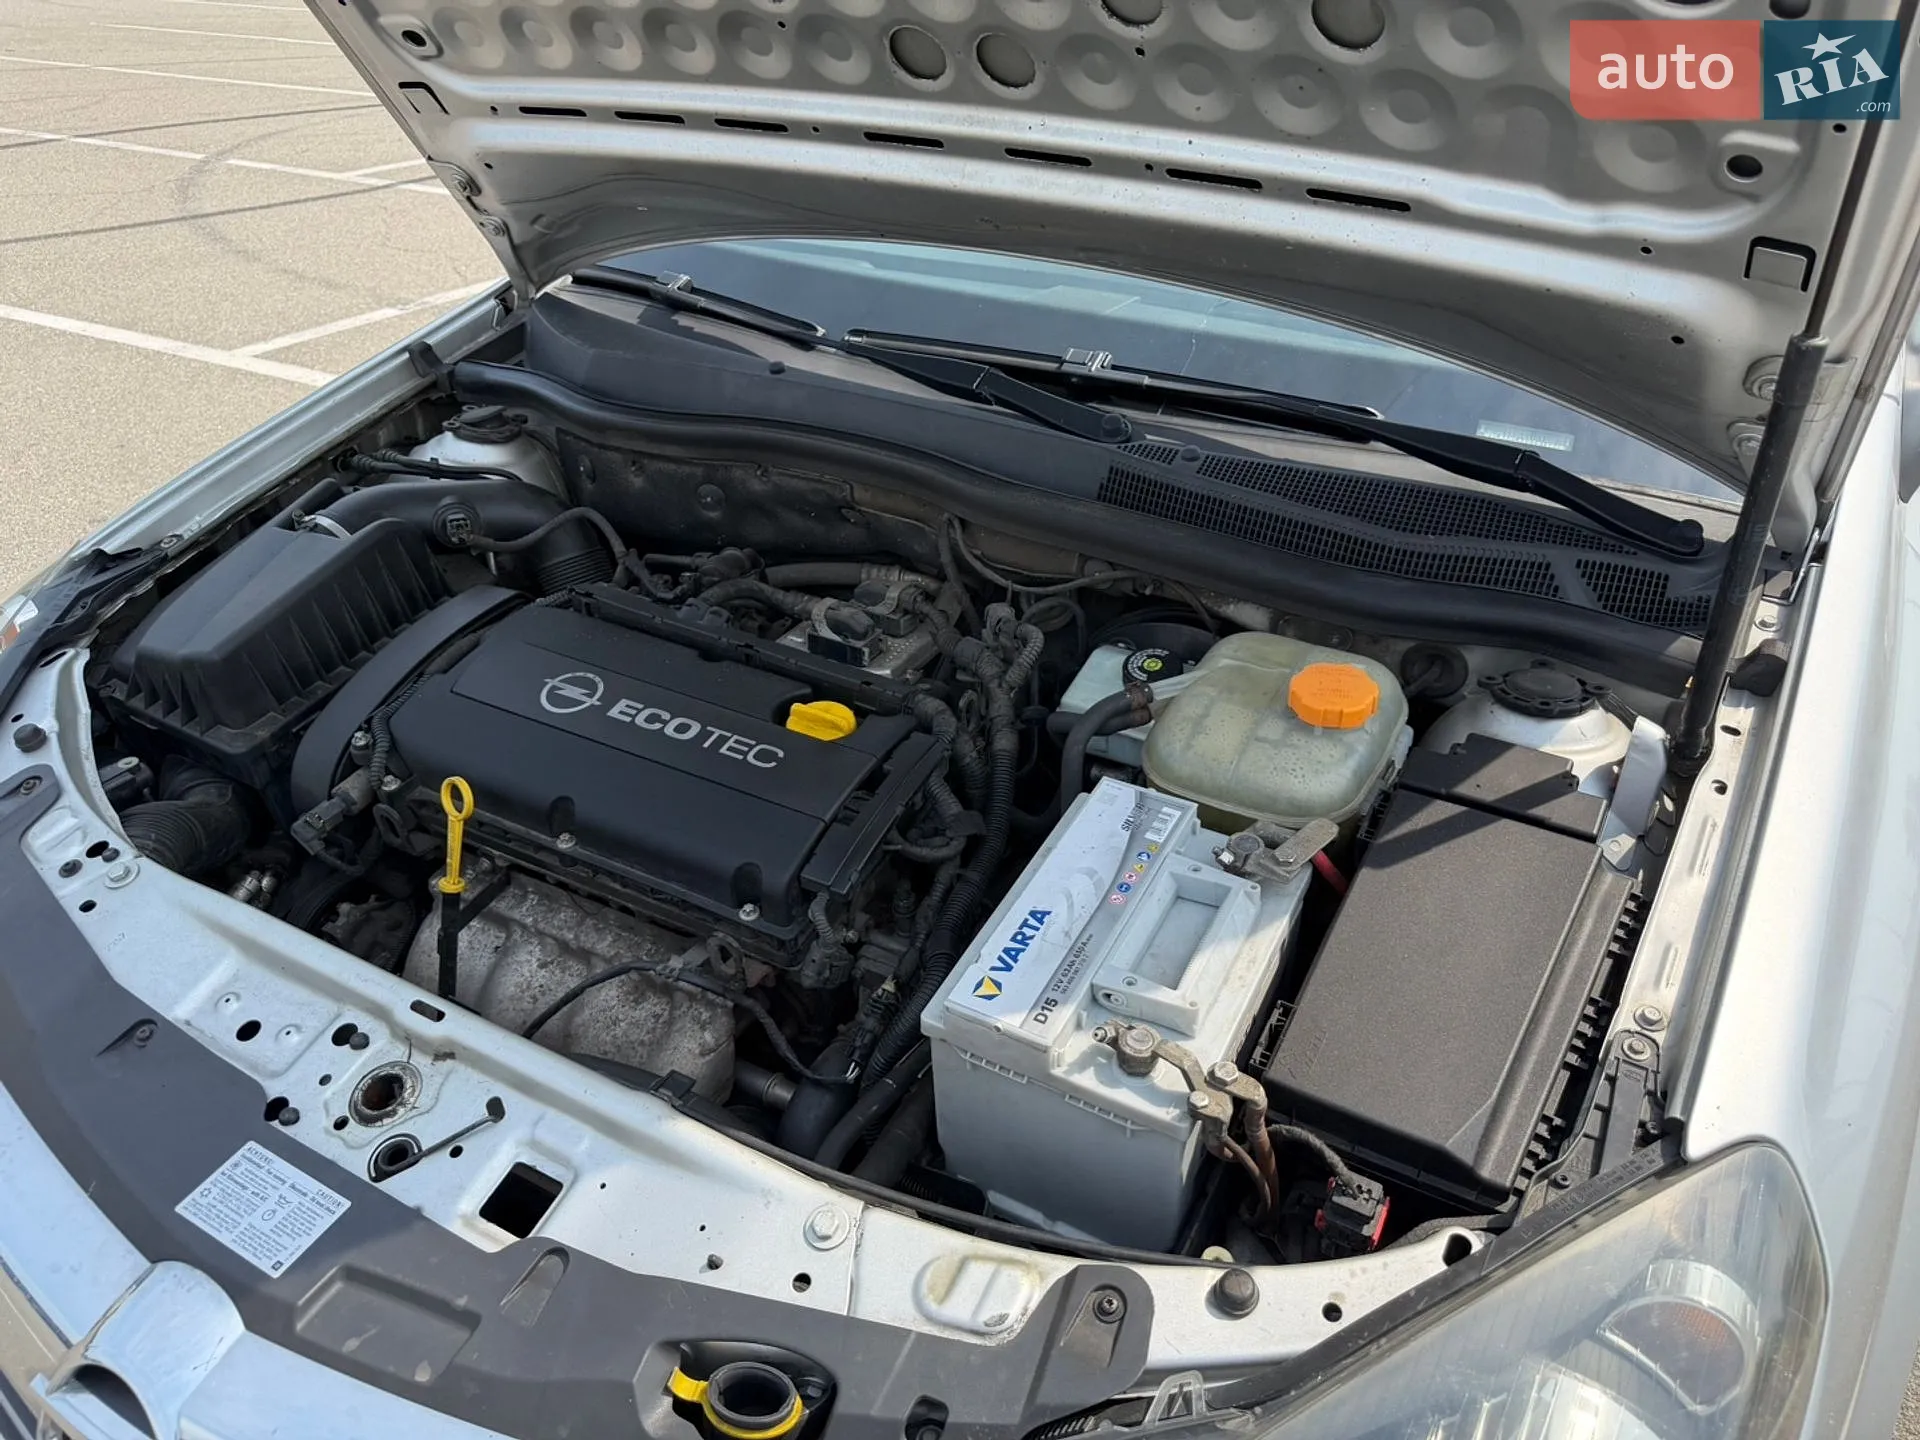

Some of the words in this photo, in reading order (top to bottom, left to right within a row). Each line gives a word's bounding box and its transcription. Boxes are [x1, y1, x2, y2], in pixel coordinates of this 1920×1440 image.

[606, 698, 785, 769] ECOTEC
[988, 910, 1053, 972] VARTA
[1033, 996, 1058, 1024] D15
